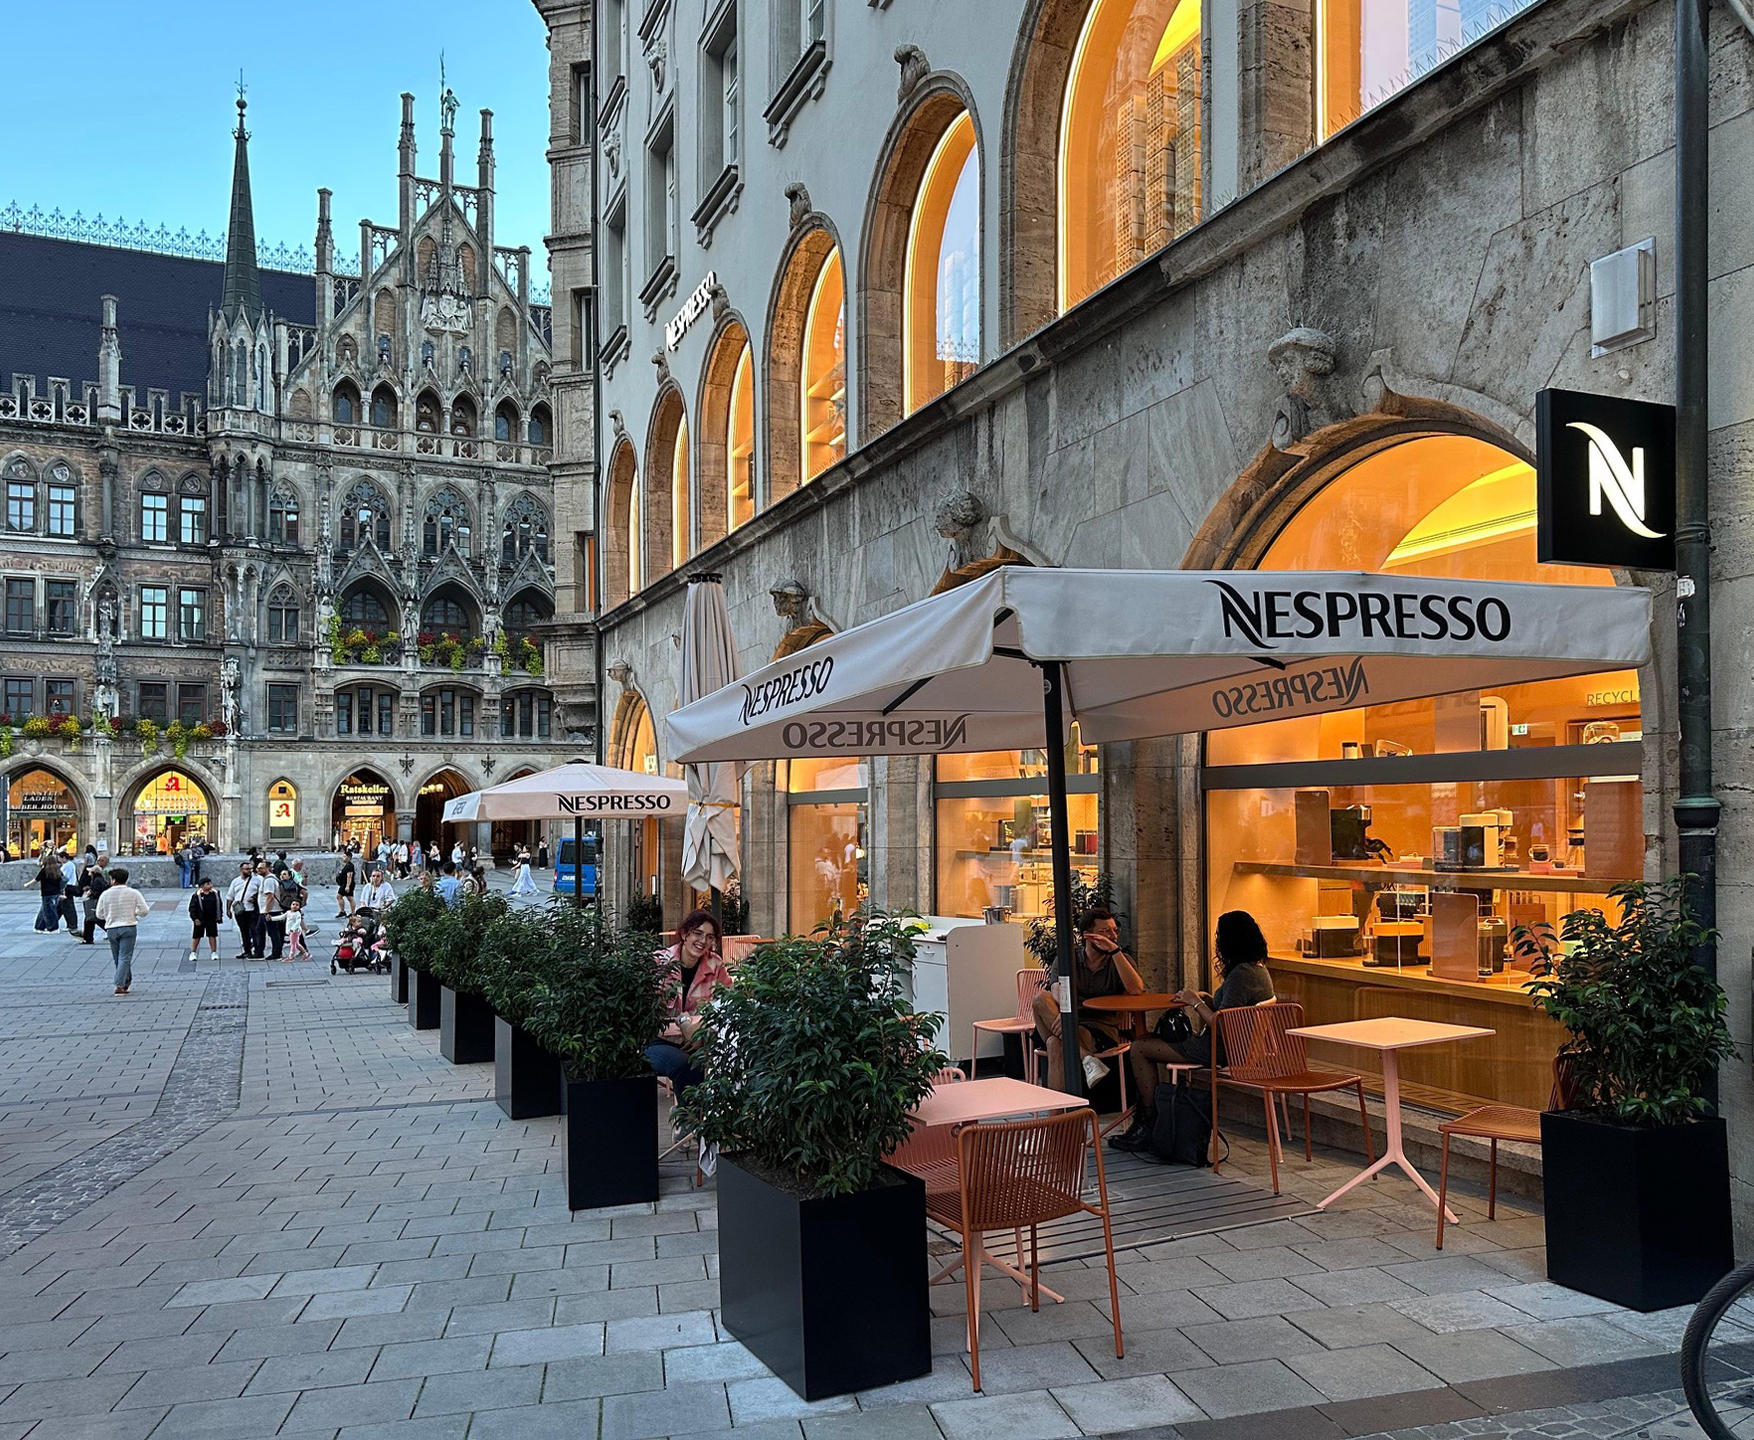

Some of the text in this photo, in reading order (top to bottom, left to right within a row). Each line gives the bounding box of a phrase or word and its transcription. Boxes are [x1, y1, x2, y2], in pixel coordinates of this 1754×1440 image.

[664, 270, 714, 351] NESPRESSO
[1566, 422, 1667, 538] N
[1202, 579, 1512, 650] NESPRESSO
[738, 656, 834, 726] NESPRESSO
[340, 784, 389, 794] Ratskeller
[553, 793, 671, 814] NESPRESSO
